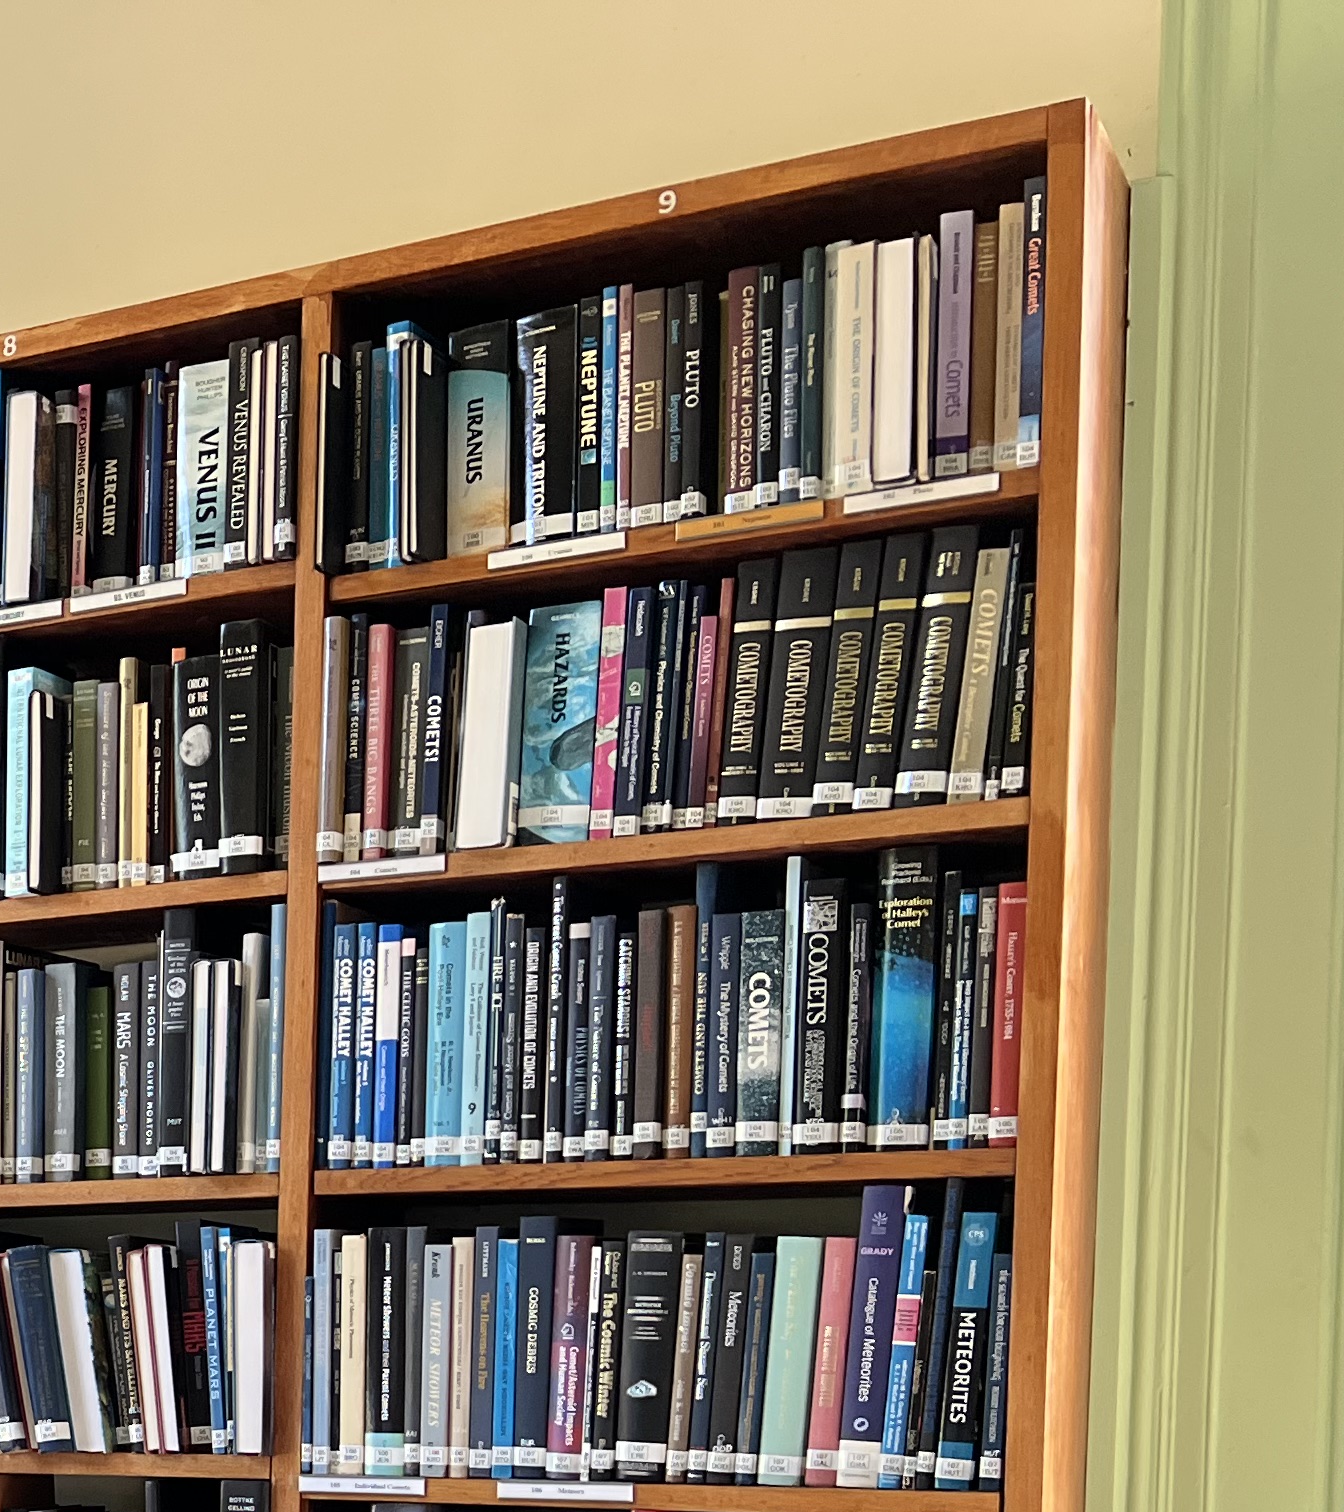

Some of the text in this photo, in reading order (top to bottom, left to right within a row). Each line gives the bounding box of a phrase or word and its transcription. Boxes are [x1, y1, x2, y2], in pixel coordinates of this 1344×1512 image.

[658, 190, 676, 214] 9
[1026, 238, 1041, 315] Great Comets
[3, 335, 17, 356] 8
[685, 349, 700, 408] PLUTO
[739, 286, 755, 487] CHASING NEW HORIZONS
[944, 360, 964, 418] Comets
[466, 397, 484, 484] URANUS
[530, 346, 547, 518] NEPTUNE AND TRITON
[580, 350, 597, 448] NEPTUNE
[634, 381, 655, 433] PLUTO
[75, 407, 88, 537] EXPLORING MERCURY
[102, 459, 118, 536] MERCURY
[195, 426, 220, 550] VENUS II
[230, 399, 249, 529] VENUS REVEALED
[551, 632, 571, 723] HAZARDS
[868, 622, 906, 735] COMETOGRAPHY
[913, 616, 953, 731] COMETOGRAPHY
[971, 588, 998, 675] COMETS
[424, 695, 441, 762] COMETS!
[729, 642, 761, 752] COMETOGRAPHY
[779, 639, 813, 752] COMETOGRAPHY
[828, 631, 864, 743] COMETOGRAPHY
[116, 975, 131, 1049] NOLAN MARS
[360, 958, 375, 1057] COMET HALLEY
[523, 941, 540, 1089] ORIGIN AND EVOLUTION OF COMETS
[747, 972, 771, 1070] COMETS
[806, 933, 829, 1024] COMETS
[55, 1015, 65, 1078] THE MOON
[206, 1288, 220, 1400] PLANET MARS
[428, 1298, 442, 1427] METEOR SHOWERS
[526, 1287, 539, 1374] COSMIC DEBRIS
[596, 1292, 617, 1418] The Cosmic Winter
[857, 1278, 879, 1402] Catalogue of Meteorites
[949, 1312, 976, 1424] METEORITES
